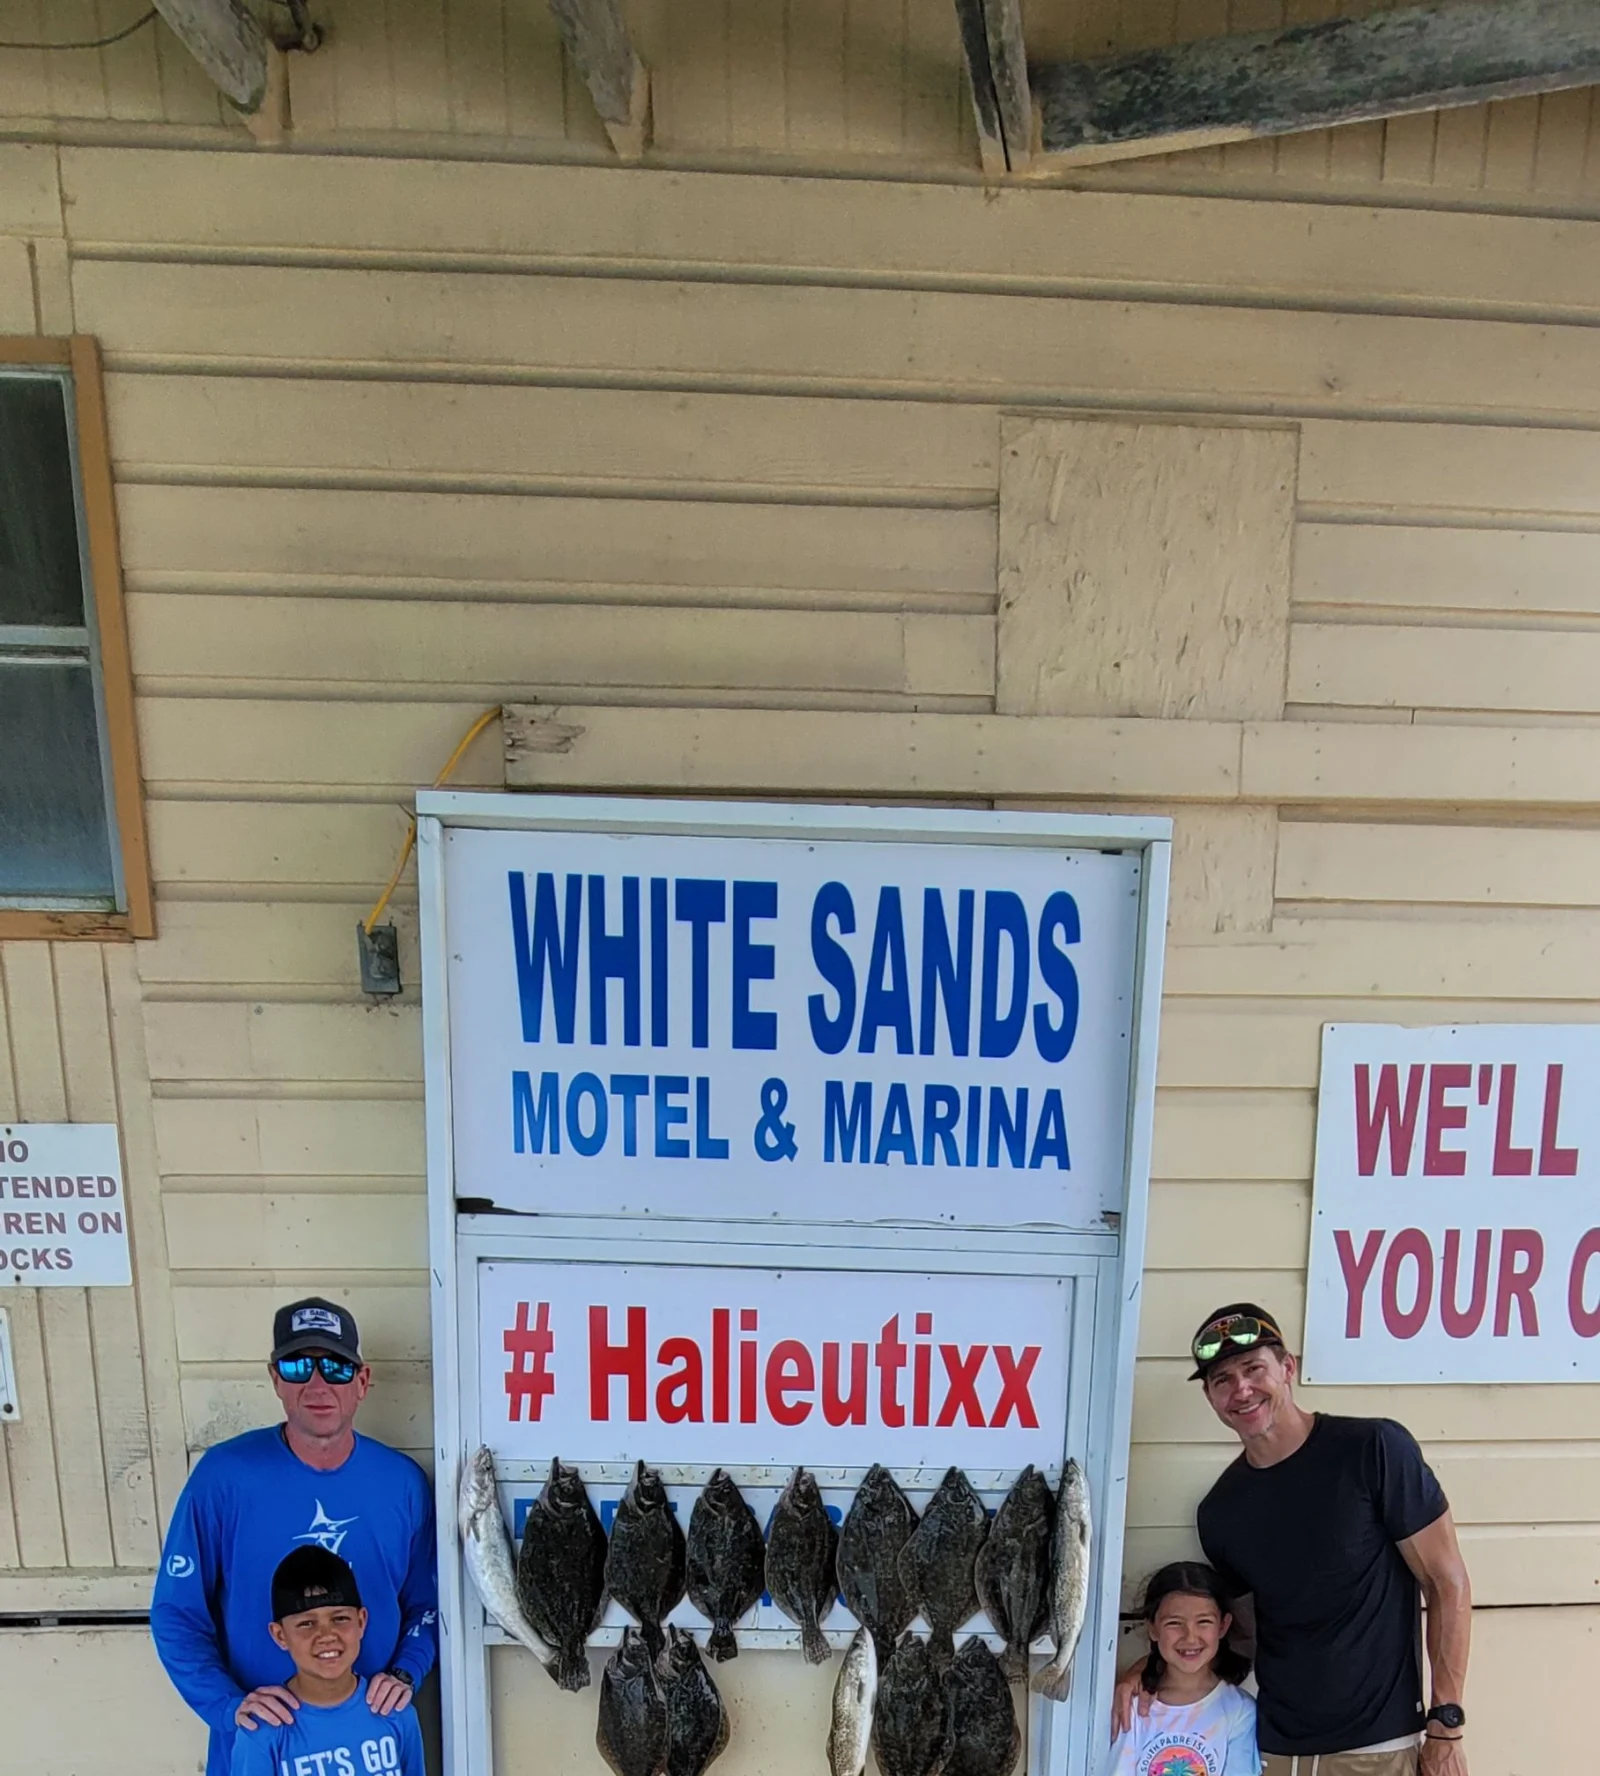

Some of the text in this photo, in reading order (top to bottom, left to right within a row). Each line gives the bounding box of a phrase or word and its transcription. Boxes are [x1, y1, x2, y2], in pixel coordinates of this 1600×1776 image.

[507, 870, 1082, 1064] WHITE SANDS
[0, 1140, 29, 1163] O
[511, 1070, 1072, 1171] MOTEL & MARINA
[1353, 1063, 1580, 1177] WE'LL
[3, 1211, 123, 1235] REN ON
[1332, 1227, 1544, 1340] YOUR
[504, 1301, 1043, 1430] # Halieutixx
[361, 1735, 398, 1774] GO
[1140, 1735, 1217, 1773] SOUTH PADRE ISLAND
